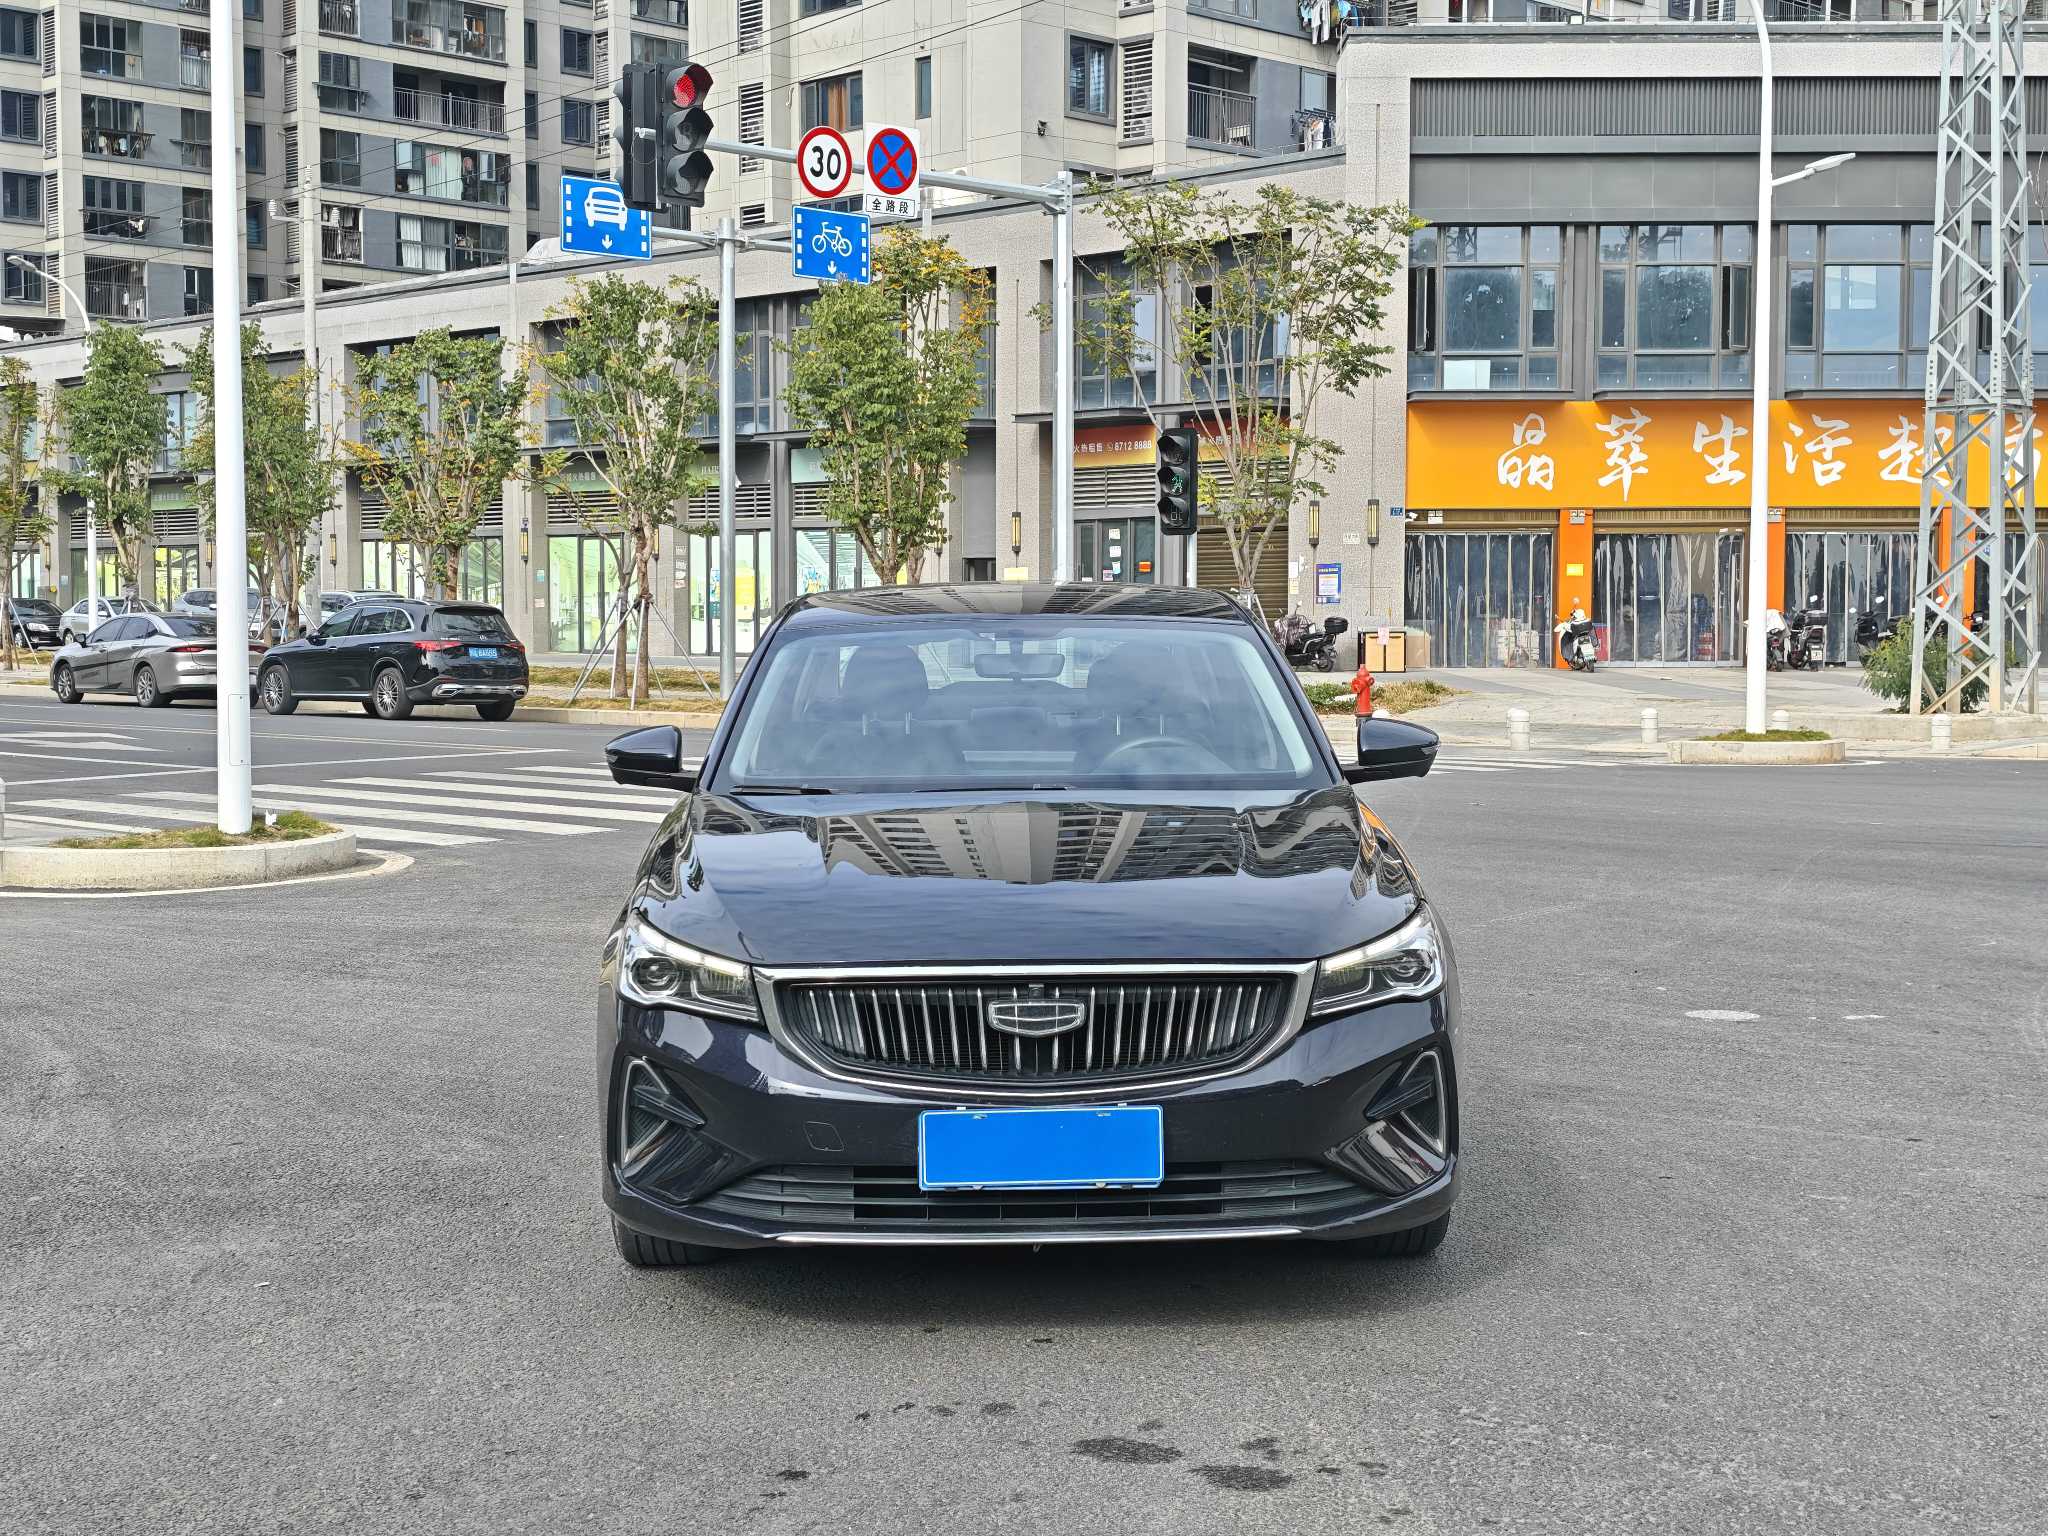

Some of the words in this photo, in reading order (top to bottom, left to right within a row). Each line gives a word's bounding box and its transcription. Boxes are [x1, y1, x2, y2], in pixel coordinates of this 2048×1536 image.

[810, 145, 841, 180] 30
[872, 198, 908, 214] 全路段
